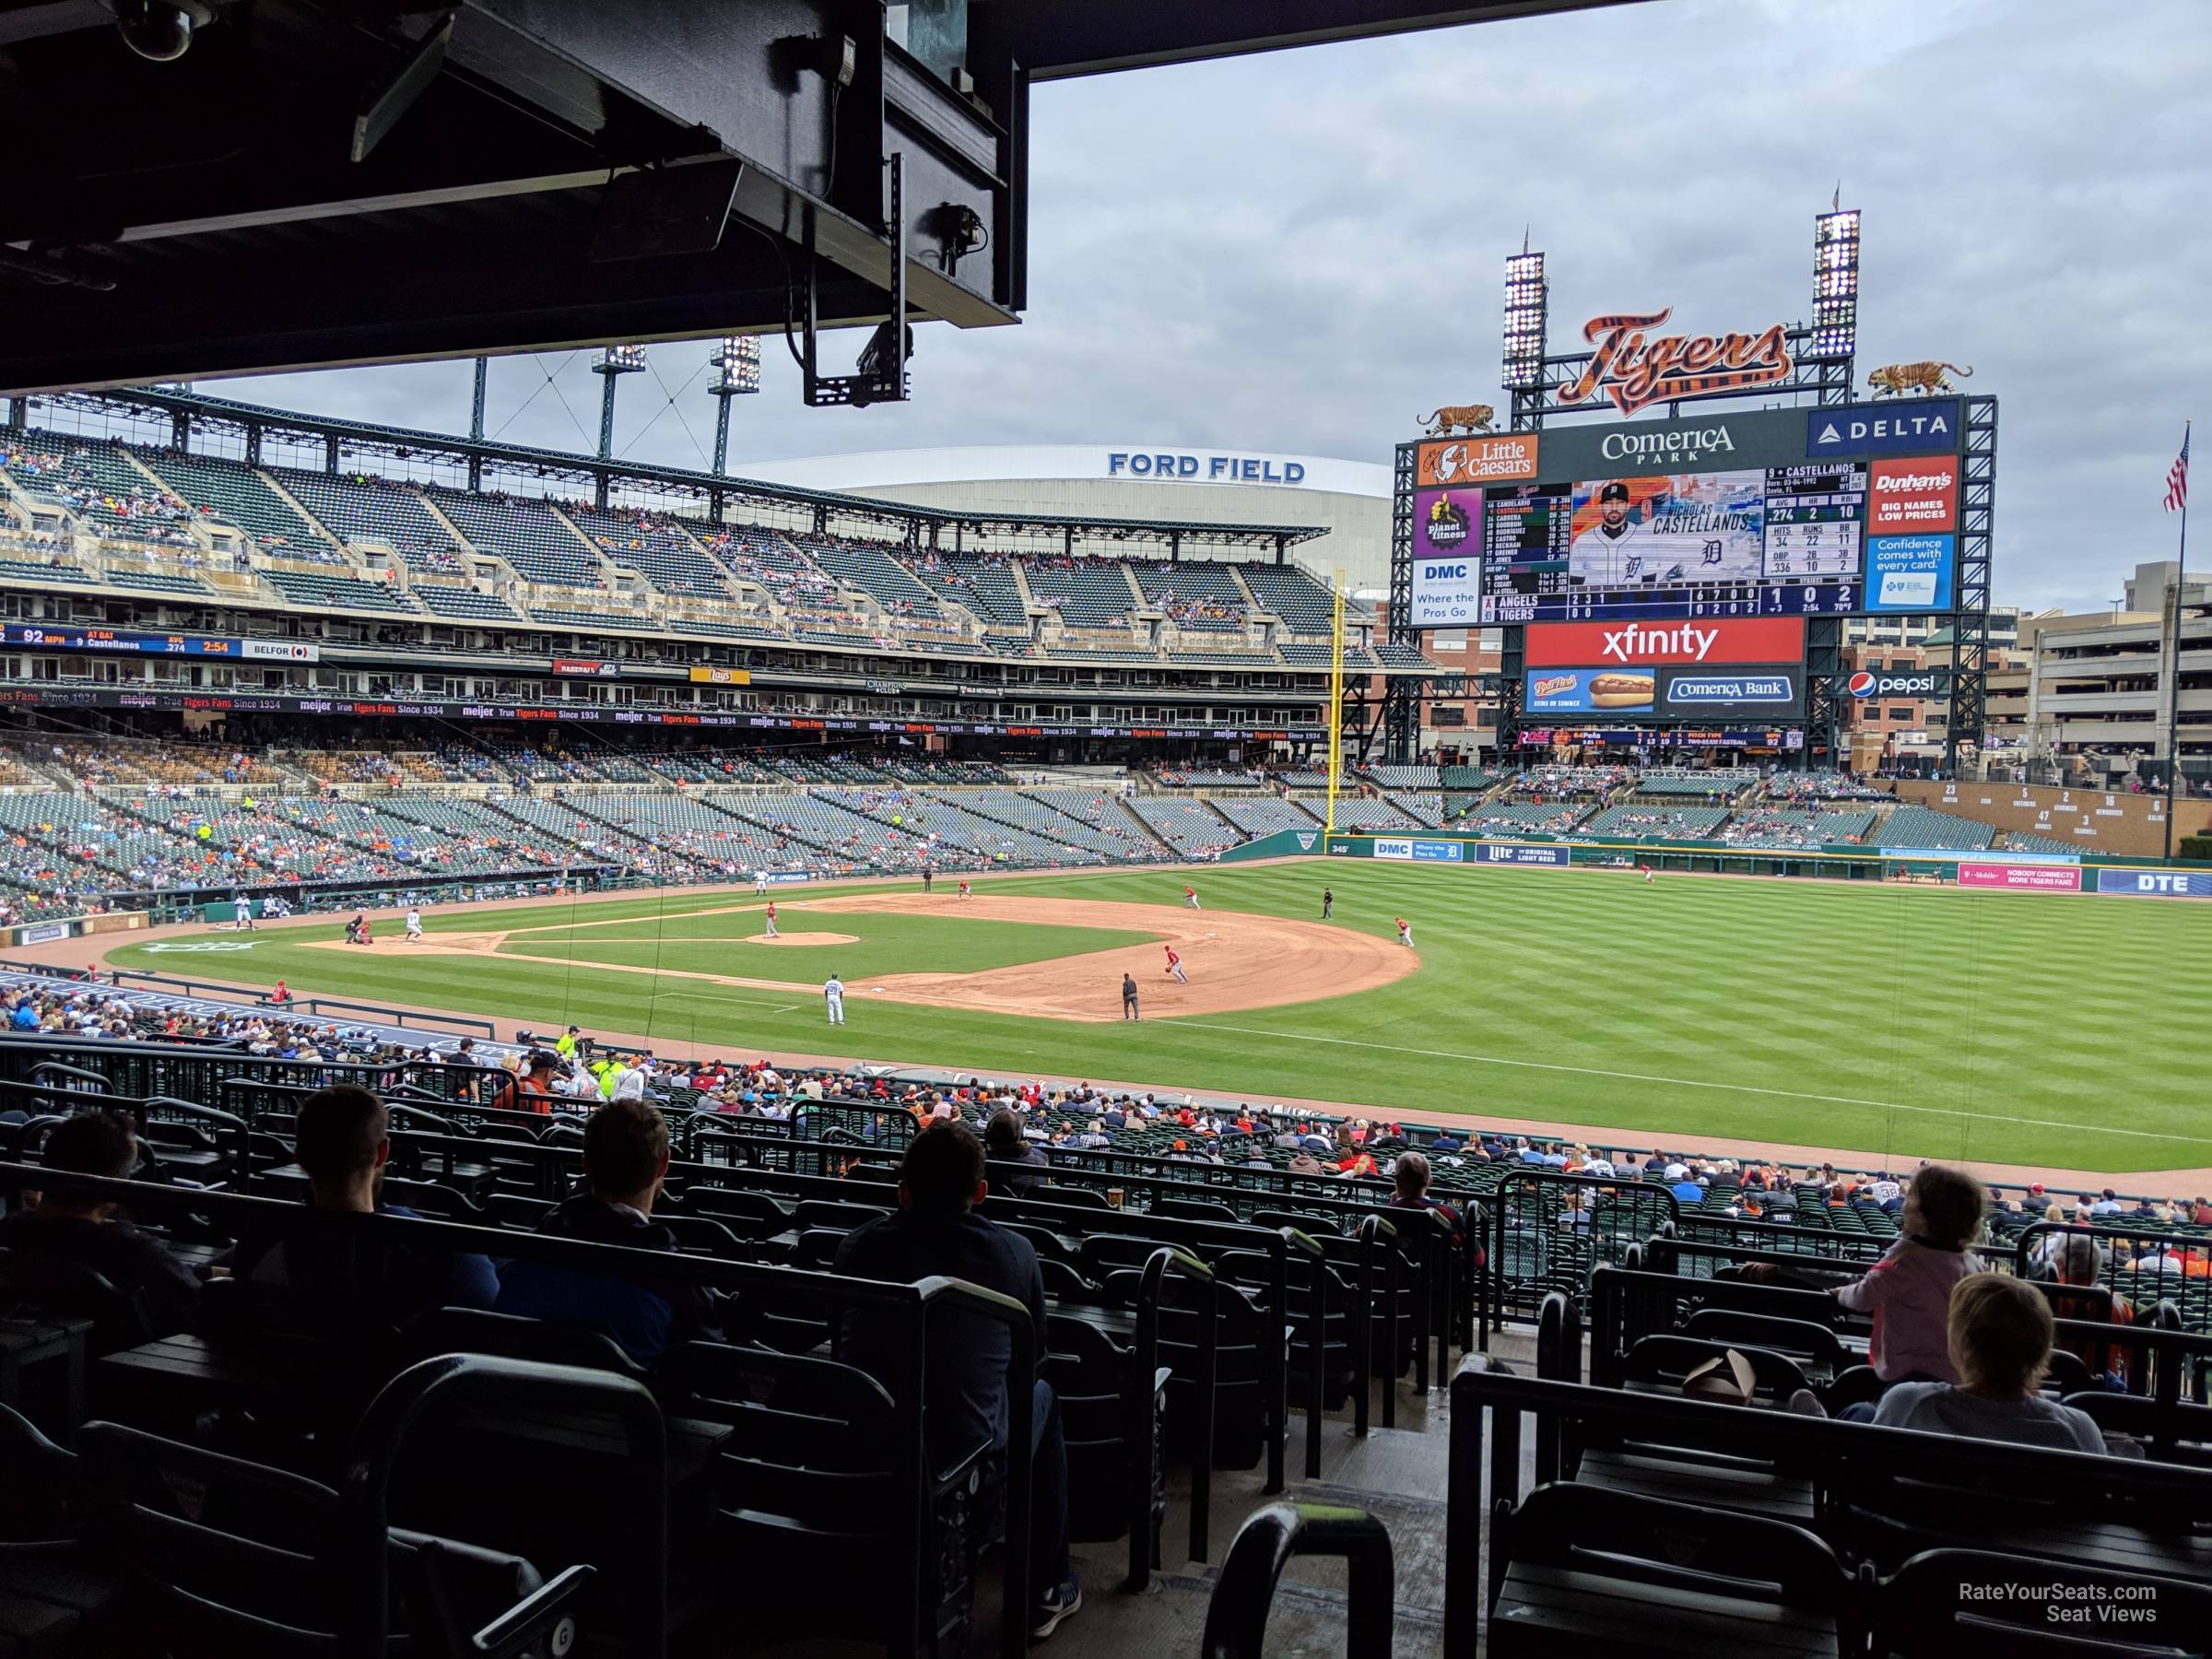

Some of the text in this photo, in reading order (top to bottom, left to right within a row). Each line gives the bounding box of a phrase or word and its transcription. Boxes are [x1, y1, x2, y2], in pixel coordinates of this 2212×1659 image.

[1557, 306, 1794, 418] Tigers
[1850, 416, 1947, 440] DELTA
[1482, 442, 1525, 461] Little
[1637, 451, 1699, 465] PARK
[1109, 453, 1305, 483] FORD FIELD
[1469, 458, 1531, 477] Caesars
[1769, 463, 1855, 477] 9 CASTELLANOS
[1876, 472, 1952, 489] Dunham's
[1641, 499, 1653, 522] 9
[1667, 503, 1712, 517] NICHOLAS
[1881, 500, 1944, 512] BIG NAMES
[1769, 505, 1854, 522] .274 2 10
[1877, 510, 1947, 522] LOW PRICES
[1429, 521, 1460, 535] planet
[1653, 512, 1750, 535] CASTELLANOS
[1773, 524, 1850, 535] HITS RUNS BB
[1432, 529, 1466, 540] fitness
[1776, 535, 1850, 547] 34 22 11
[1877, 538, 1942, 550] Confidence
[1806, 550, 1817, 559] 2B
[1838, 549, 1849, 558] 3B
[1877, 547, 1942, 560] comes with
[1771, 560, 1847, 573] .336 10 2
[1877, 559, 1938, 572] every card.
[1425, 565, 1467, 580] DMC
[1417, 593, 1475, 604] Where the
[1499, 594, 1605, 607] ANGELS 2 3 1
[1771, 585, 1851, 603] 1 0 2
[1423, 607, 1466, 618] Pros Go
[1803, 603, 1853, 611] 2:54 70°F
[1499, 609, 1535, 621] TIGERS
[23, 629, 65, 643] 92 MPH
[88, 630, 98, 639] AT
[99, 631, 113, 640] BAT
[76, 638, 229, 653] 9 Castellanos 2:54
[1602, 622, 1719, 662] xfinity
[254, 645, 288, 655] BELFOR
[867, 680, 908, 689] CHAMPIONS
[1746, 682, 1783, 695] Bank
[1879, 675, 1935, 693] pepsi
[300, 700, 443, 714] meijer True Tigers Fans Since 1934
[463, 705, 599, 720] meijer True Tigers Fans Since 1934
[616, 711, 642, 723] meijer
[648, 714, 662, 723] True
[663, 714, 682, 724] Tigers
[684, 715, 699, 724] Fans
[700, 716, 718, 724] Since
[1214, 729, 1237, 739] meijer
[1254, 731, 1272, 739] Tigers
[1518, 730, 1550, 745] ROSE
[1946, 784, 1956, 795] 23
[2022, 787, 2028, 798] 5
[2063, 792, 2069, 802] 2
[2154, 800, 2160, 812] 6
[2038, 811, 2050, 821] 47
[2083, 815, 2089, 826] 3
[1332, 844, 1349, 853] 345'
[1378, 843, 1409, 854] DMC
[1726, 840, 1821, 851] MotorCityCasino.com
[1488, 845, 1513, 862] Lite
[2138, 875, 2189, 891] DTE
[1880, 1188, 1898, 1198] 38
[559, 1628, 569, 1646] G
